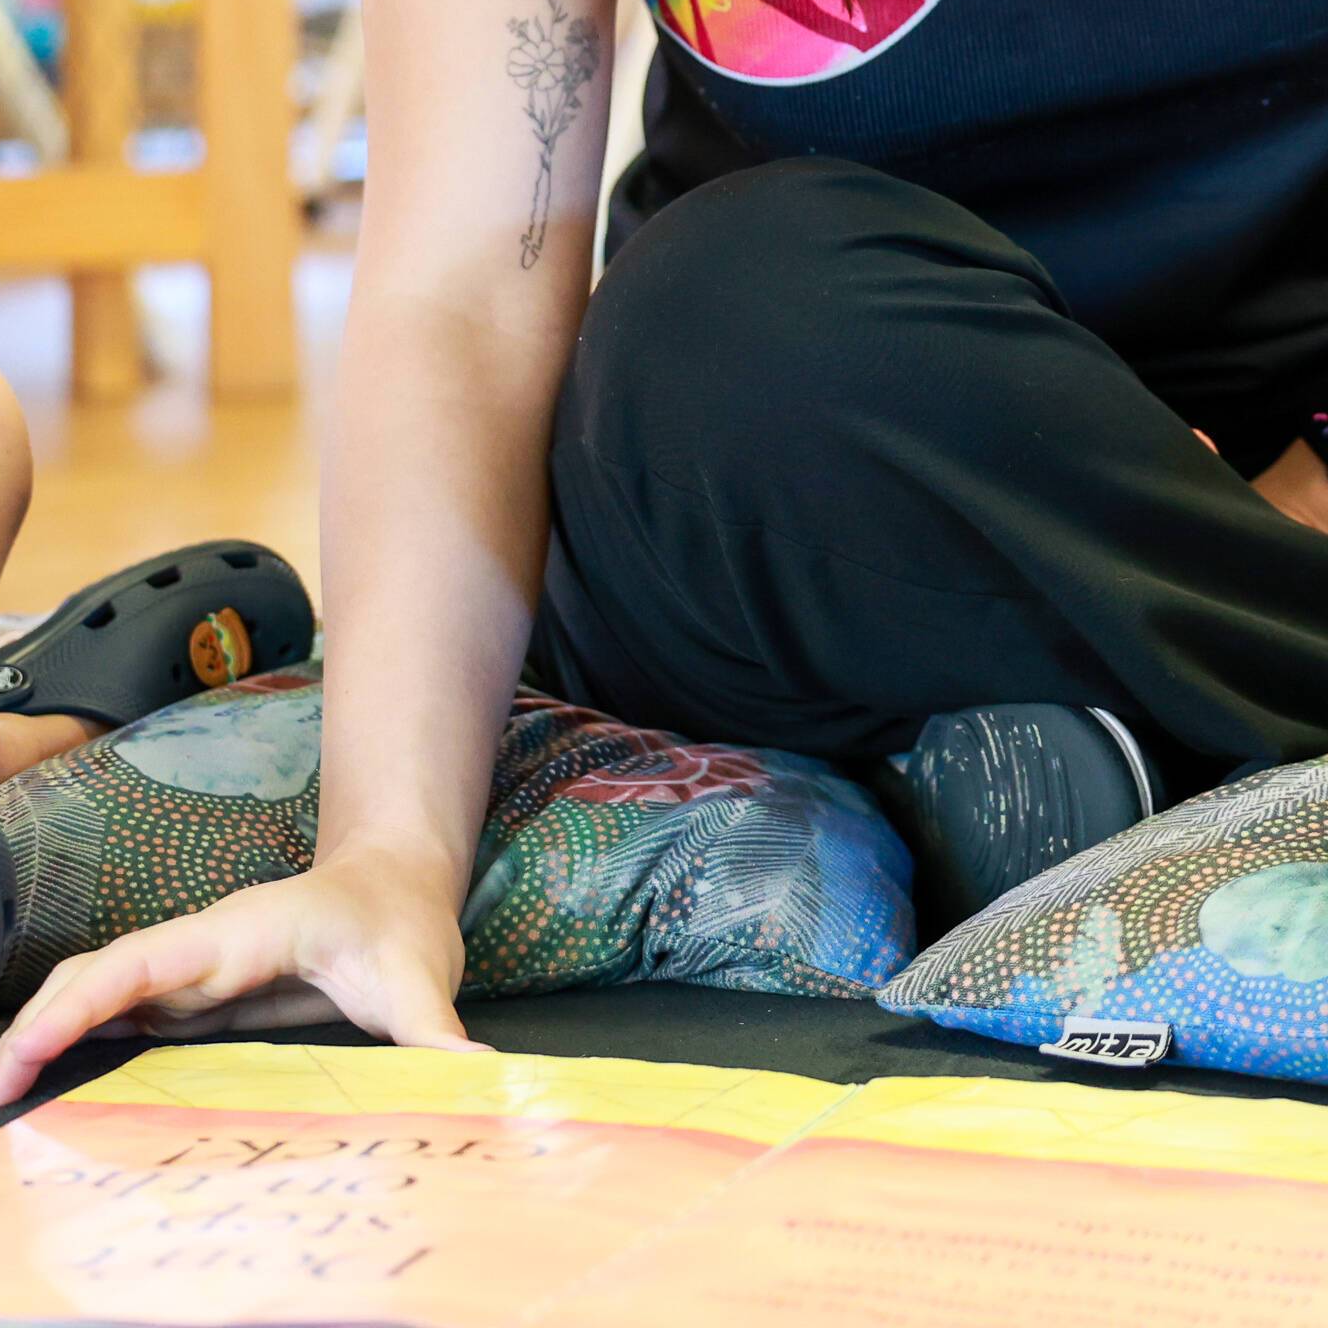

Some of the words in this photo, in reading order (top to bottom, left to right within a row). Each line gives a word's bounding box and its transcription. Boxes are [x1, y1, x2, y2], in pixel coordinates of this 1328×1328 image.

[1062, 1034, 1160, 1059] mta
[154, 1136, 550, 1171] crack!
[264, 1174, 422, 1197] on
